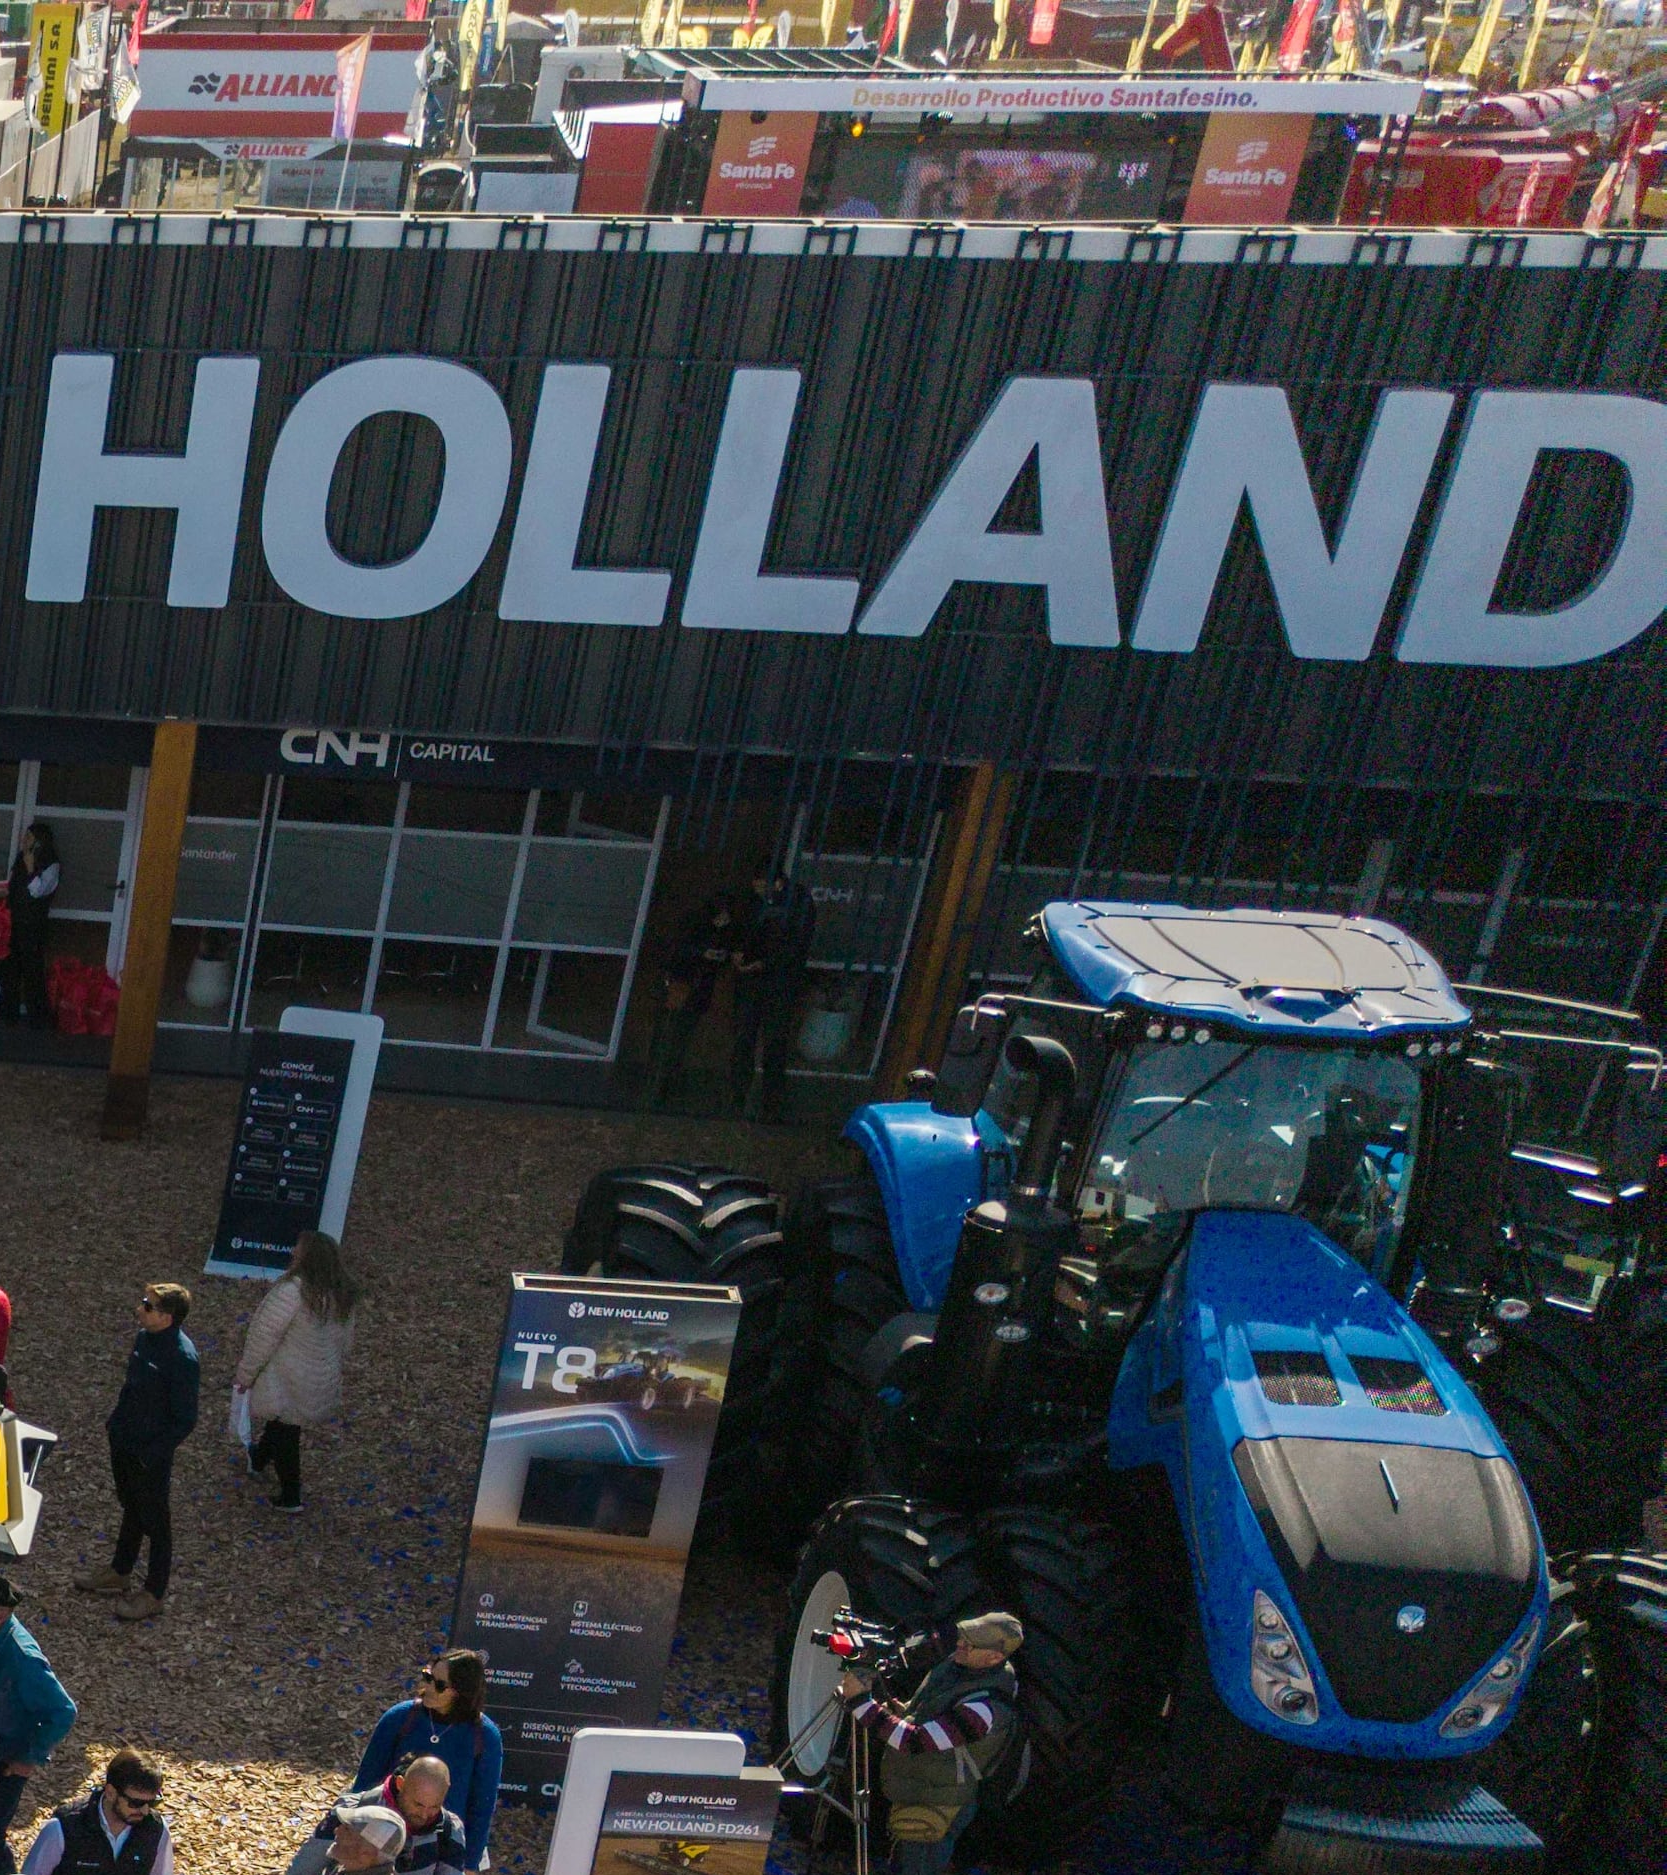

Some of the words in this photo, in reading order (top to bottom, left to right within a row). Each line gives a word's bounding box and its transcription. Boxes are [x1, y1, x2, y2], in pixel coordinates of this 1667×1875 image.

[40, 56, 58, 127] BERTINI
[215, 73, 339, 102] ALLIANC
[852, 87, 971, 108] Desarrollo
[975, 87, 1104, 108] Productivo
[1108, 87, 1259, 109] Santafesino.
[237, 142, 308, 160] ALLIANCE
[719, 162, 772, 180] Santa
[773, 164, 795, 180] Fe
[1203, 167, 1261, 185] Santa
[1263, 168, 1286, 186] Fe
[26, 350, 1667, 672] HOLLAND
[279, 727, 391, 768] CNH
[409, 742, 495, 763] CAPITAL
[243, 1240, 261, 1250] NEW
[261, 1241, 294, 1253] HOLLAN
[587, 1306, 614, 1317] NEW
[615, 1308, 669, 1321] HOLLAND
[517, 1331, 557, 1342] NUEVO
[514, 1342, 597, 1394] T8
[476, 1612, 506, 1622] NUEVAS
[506, 1614, 548, 1625] POTENCIAS
[480, 1621, 540, 1632] TRANSMISIONES
[569, 1628, 612, 1638] MEJORADO
[570, 1620, 602, 1630] SISTEMA
[603, 1621, 643, 1633] ELÉCTRICO
[561, 1675, 610, 1687] RENOVACIÓN
[611, 1680, 637, 1689] VISUAL
[564, 1684, 619, 1695] TECNOLÓGICA
[522, 1721, 556, 1732] DISEÑO
[521, 1731, 562, 1742] NATURAL
[541, 1783, 563, 1796] CN
[664, 1794, 688, 1804] NEW
[689, 1795, 737, 1806] HOLLAND
[613, 1819, 647, 1830] NEW
[648, 1820, 715, 1834] HOLLAND
[717, 1823, 760, 1836] FD261
